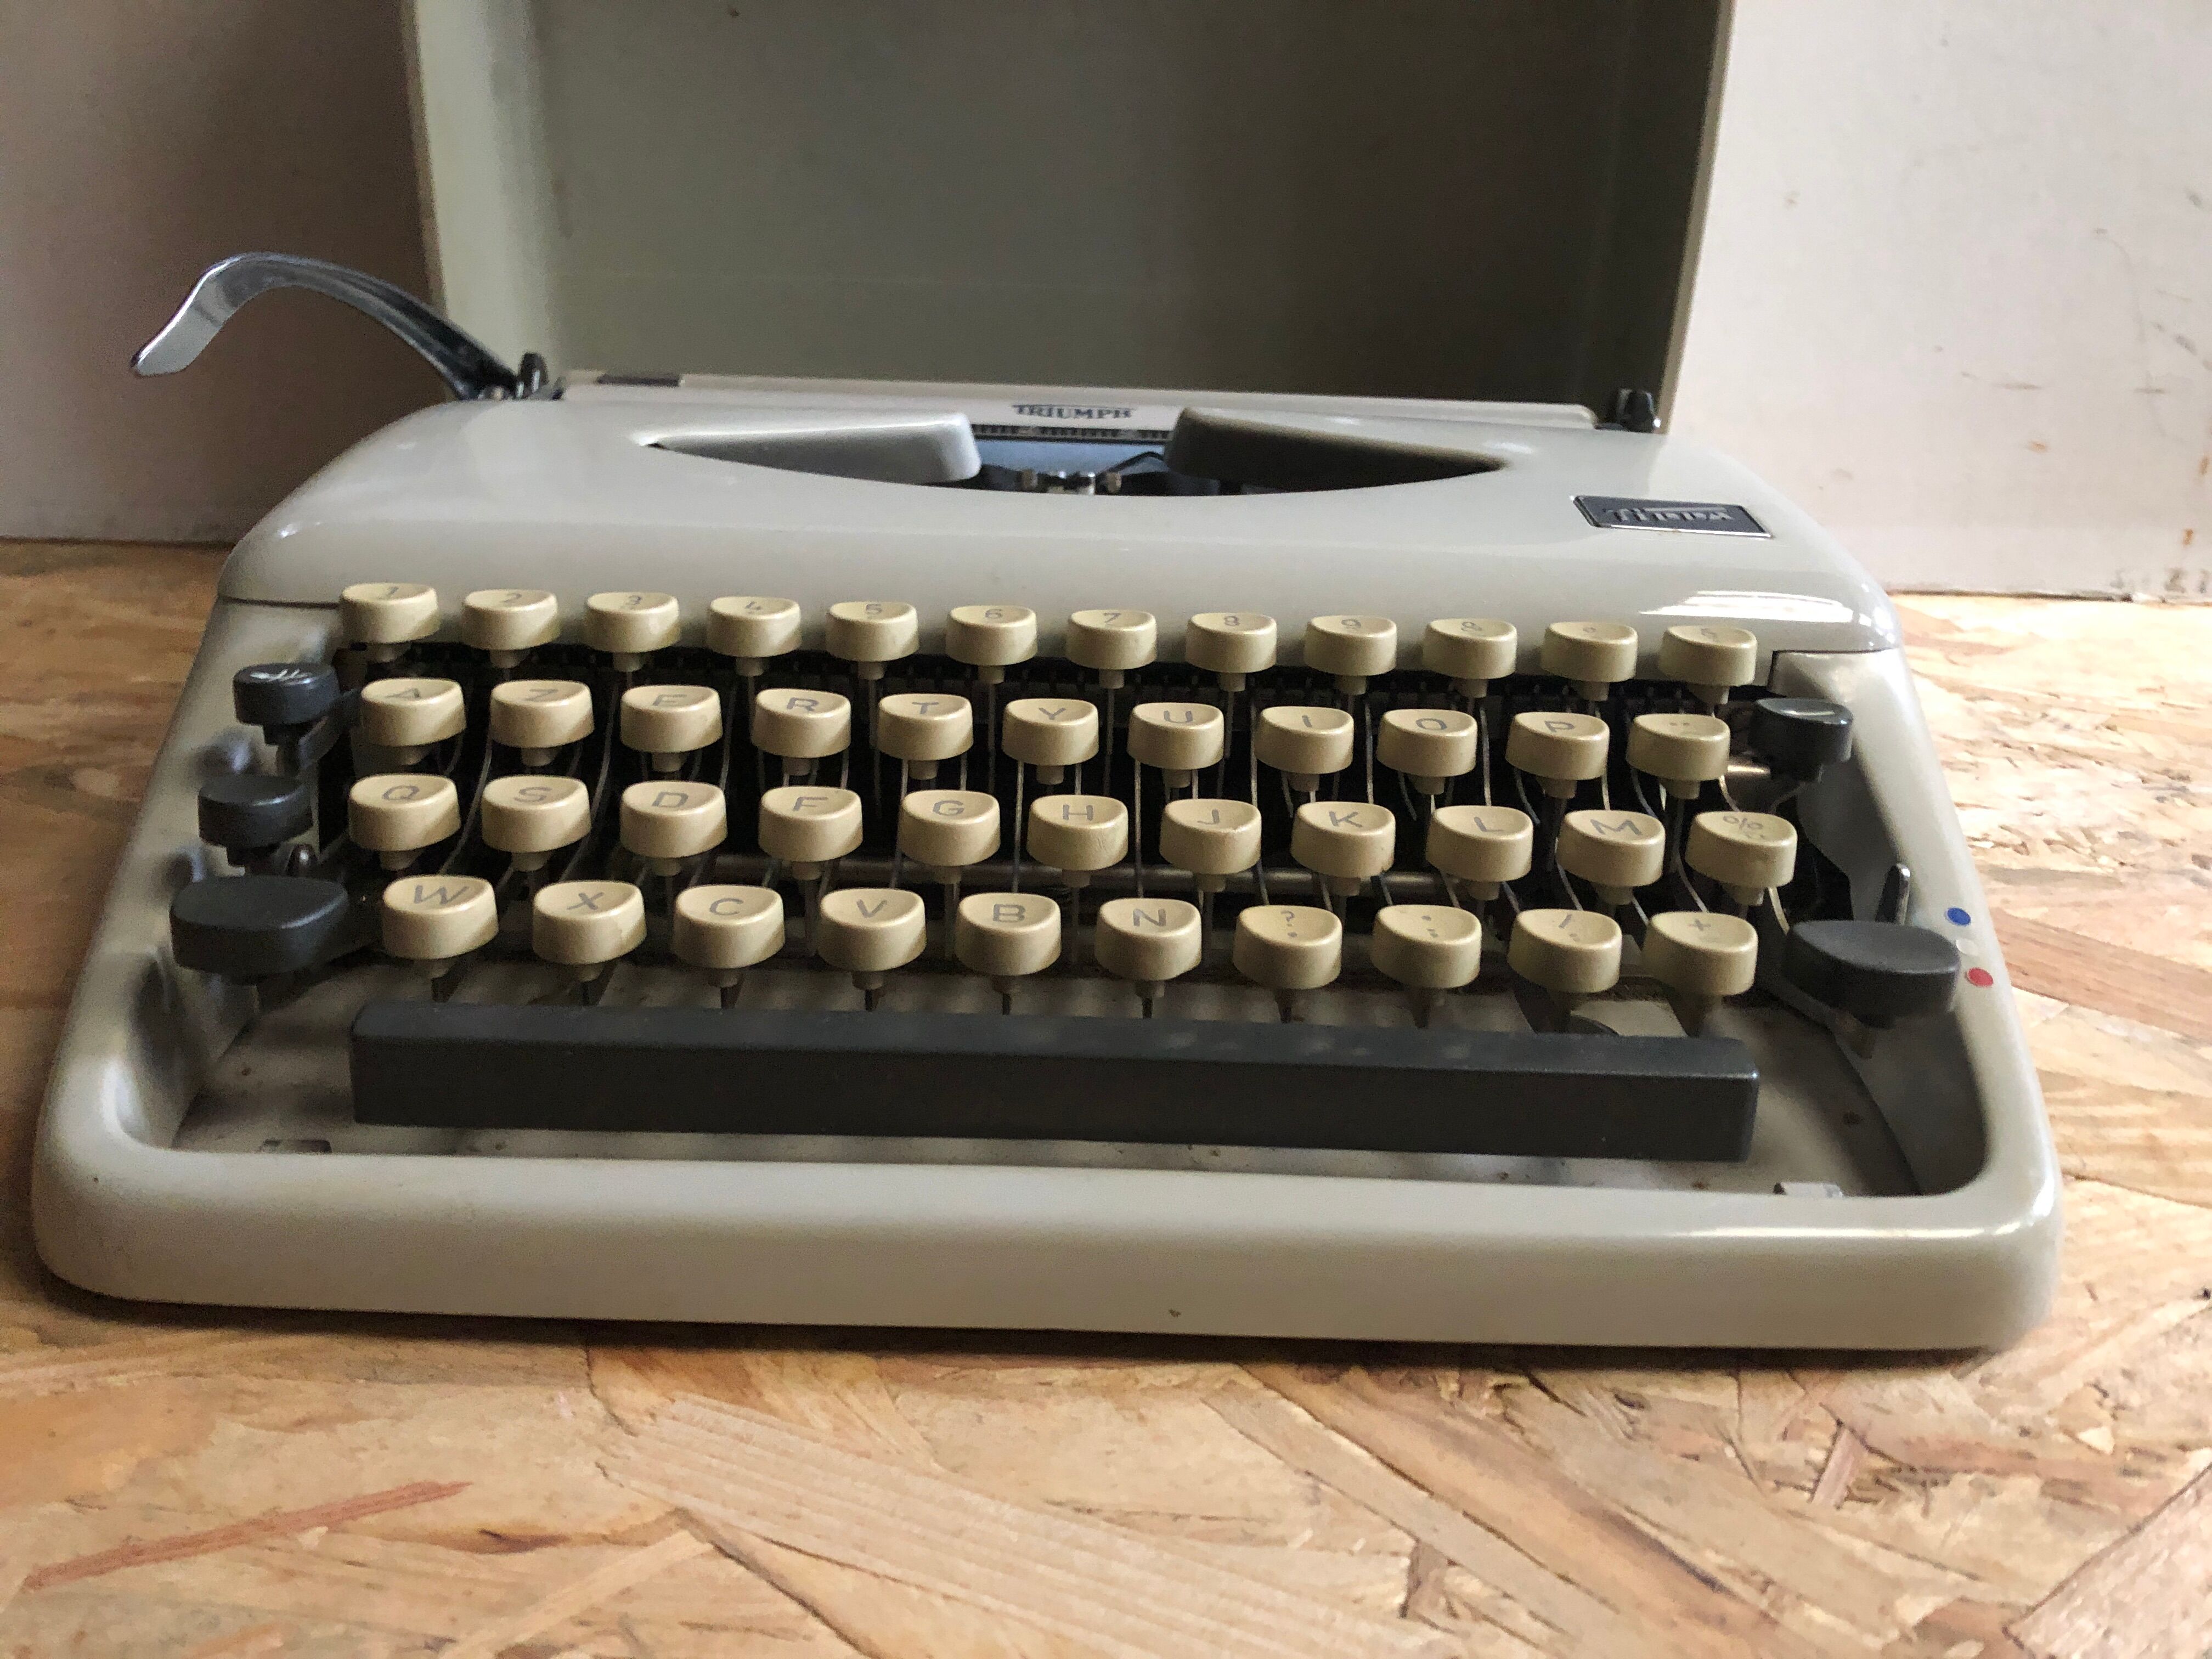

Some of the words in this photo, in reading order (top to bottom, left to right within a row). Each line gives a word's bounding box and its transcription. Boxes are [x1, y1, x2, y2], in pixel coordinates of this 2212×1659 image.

[1012, 404, 1137, 419] TRIUMPH
[985, 608, 1003, 620] 6
[1103, 612, 1121, 624] 7
[1223, 616, 1240, 627] 8
[386, 687, 420, 699] A
[523, 689, 558, 701] Z
[651, 693, 687, 706] E
[786, 697, 819, 712] R
[912, 702, 939, 714] T
[1039, 707, 1066, 720] Y
[1163, 710, 1193, 724] U
[1415, 718, 1447, 730] O
[1544, 720, 1575, 733] P
[381, 785, 420, 801] Q
[513, 786, 552, 803] S
[651, 791, 689, 808] D
[792, 796, 829, 812] F
[933, 799, 965, 816] G
[1062, 804, 1094, 821] H
[1197, 809, 1220, 825] J
[1328, 811, 1364, 828] K
[1474, 816, 1505, 832] L
[1590, 819, 1643, 836] M
[413, 884, 470, 905] W
[566, 891, 605, 911] X
[708, 898, 745, 916] C
[856, 899, 888, 919] V
[992, 903, 1026, 923] B
[1132, 908, 1167, 927] N
[1281, 910, 1296, 927] ?
